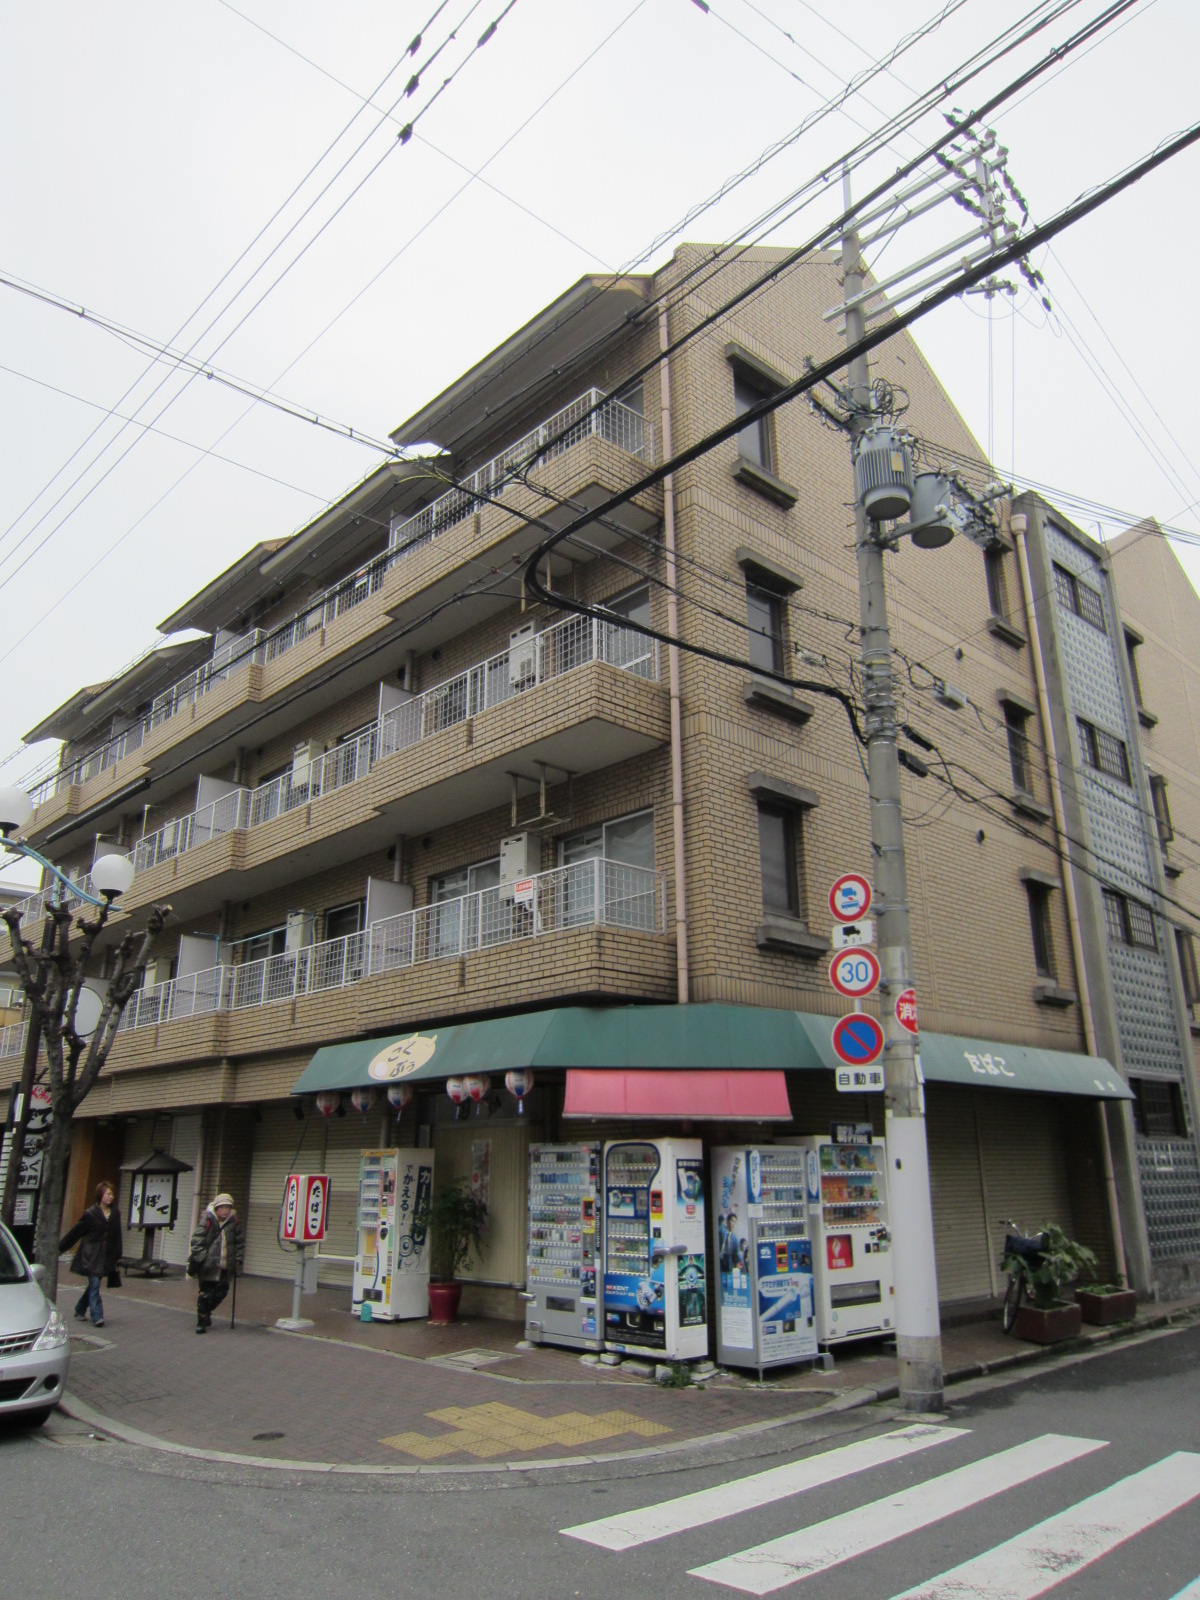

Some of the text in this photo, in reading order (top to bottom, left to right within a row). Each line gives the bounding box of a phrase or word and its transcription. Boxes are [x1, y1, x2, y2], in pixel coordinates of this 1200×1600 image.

[841, 961, 868, 983] 30
[963, 1050, 1016, 1077] たばこ
[838, 1071, 882, 1085] 自動車
[288, 1183, 296, 1228] たばこ
[310, 1185, 322, 1229] たばこ
[832, 1258, 846, 1268] FIRE
